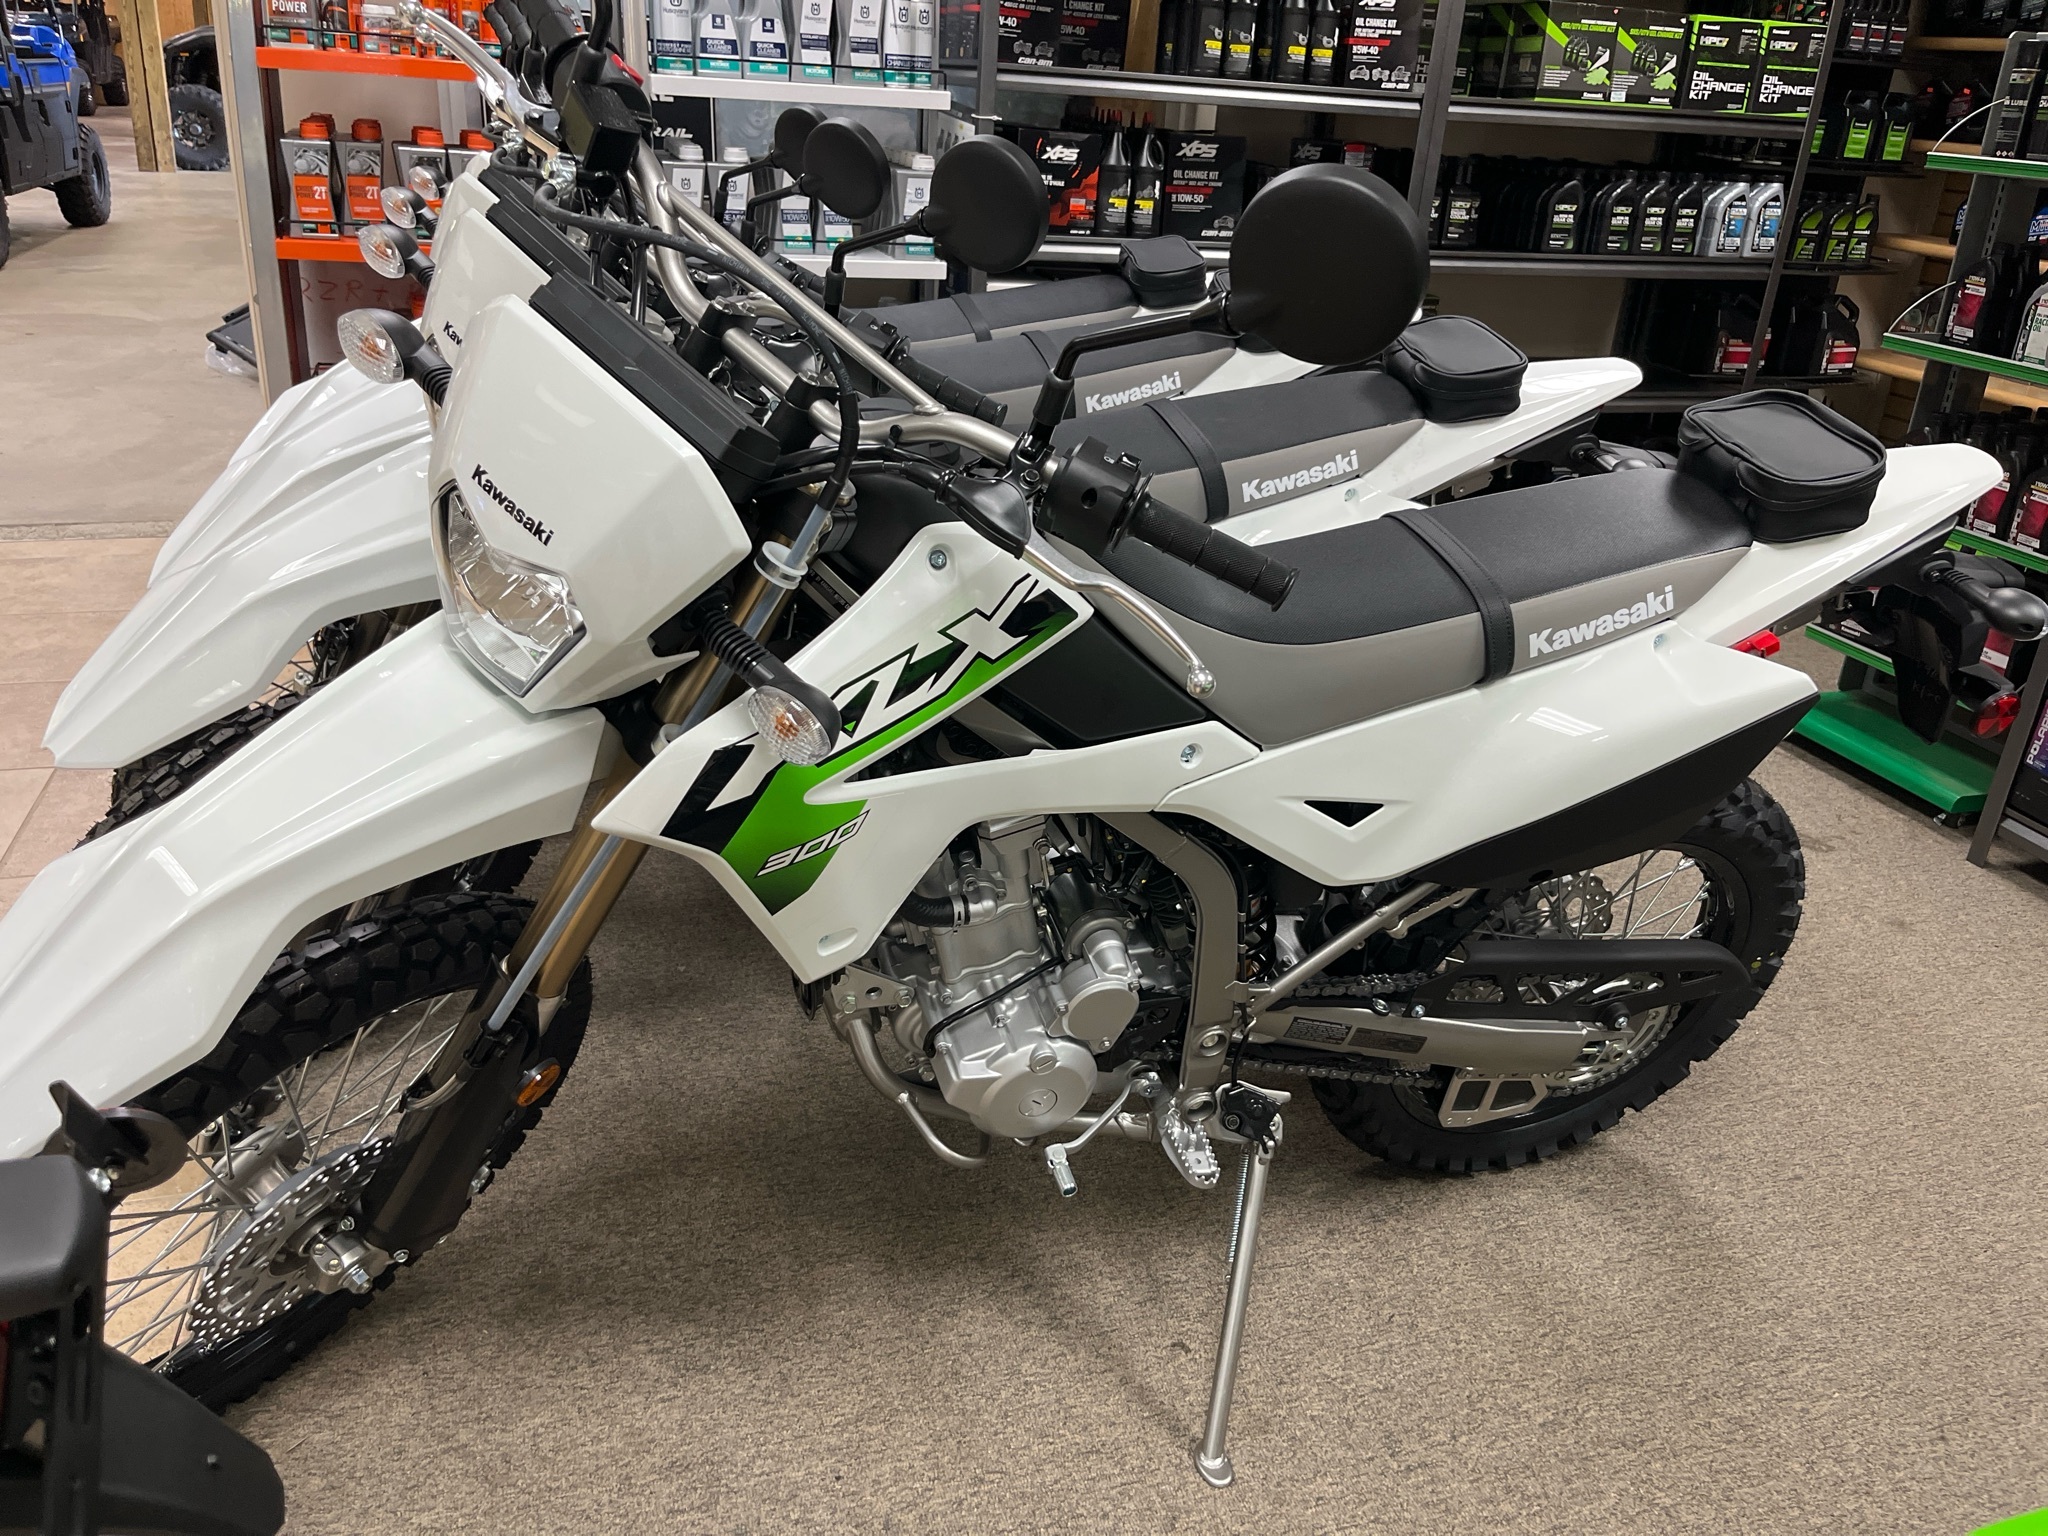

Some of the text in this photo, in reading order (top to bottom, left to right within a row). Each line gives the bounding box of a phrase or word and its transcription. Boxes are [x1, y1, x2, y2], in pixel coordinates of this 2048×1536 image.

[271, 0, 308, 13] POWER
[1069, 1, 1106, 12] CHANGE KIT
[1356, 17, 1398, 29] OIL CHANGE KIT
[1060, 24, 1085, 36] 5W-40
[1018, 56, 1054, 67] can-am
[1693, 70, 1715, 81] OIL
[1762, 74, 1784, 85] OIL
[1690, 80, 1746, 93] CHANGE
[1760, 84, 1815, 97] CHANGE
[1689, 90, 1712, 101] KIT
[1758, 93, 1781, 104] KIT
[1040, 145, 1081, 161] XPS
[1175, 140, 1220, 159] XPS
[1293, 142, 1324, 161] XPS
[1173, 169, 1220, 180] OIL CHANGE KIT
[313, 186, 327, 200] 2T
[365, 186, 379, 200] 2T
[1177, 193, 1205, 204] 10W-50
[1200, 229, 1235, 238] can-am
[721, 255, 751, 274] NICHIRIN
[2032, 324, 2042, 333] OIL
[1085, 371, 1182, 413] Kawasaki
[1241, 449, 1360, 503] Kawasaki
[471, 463, 555, 547] Kawasaki
[1528, 584, 1675, 659] Kawasaki
[753, 809, 871, 879] 300
